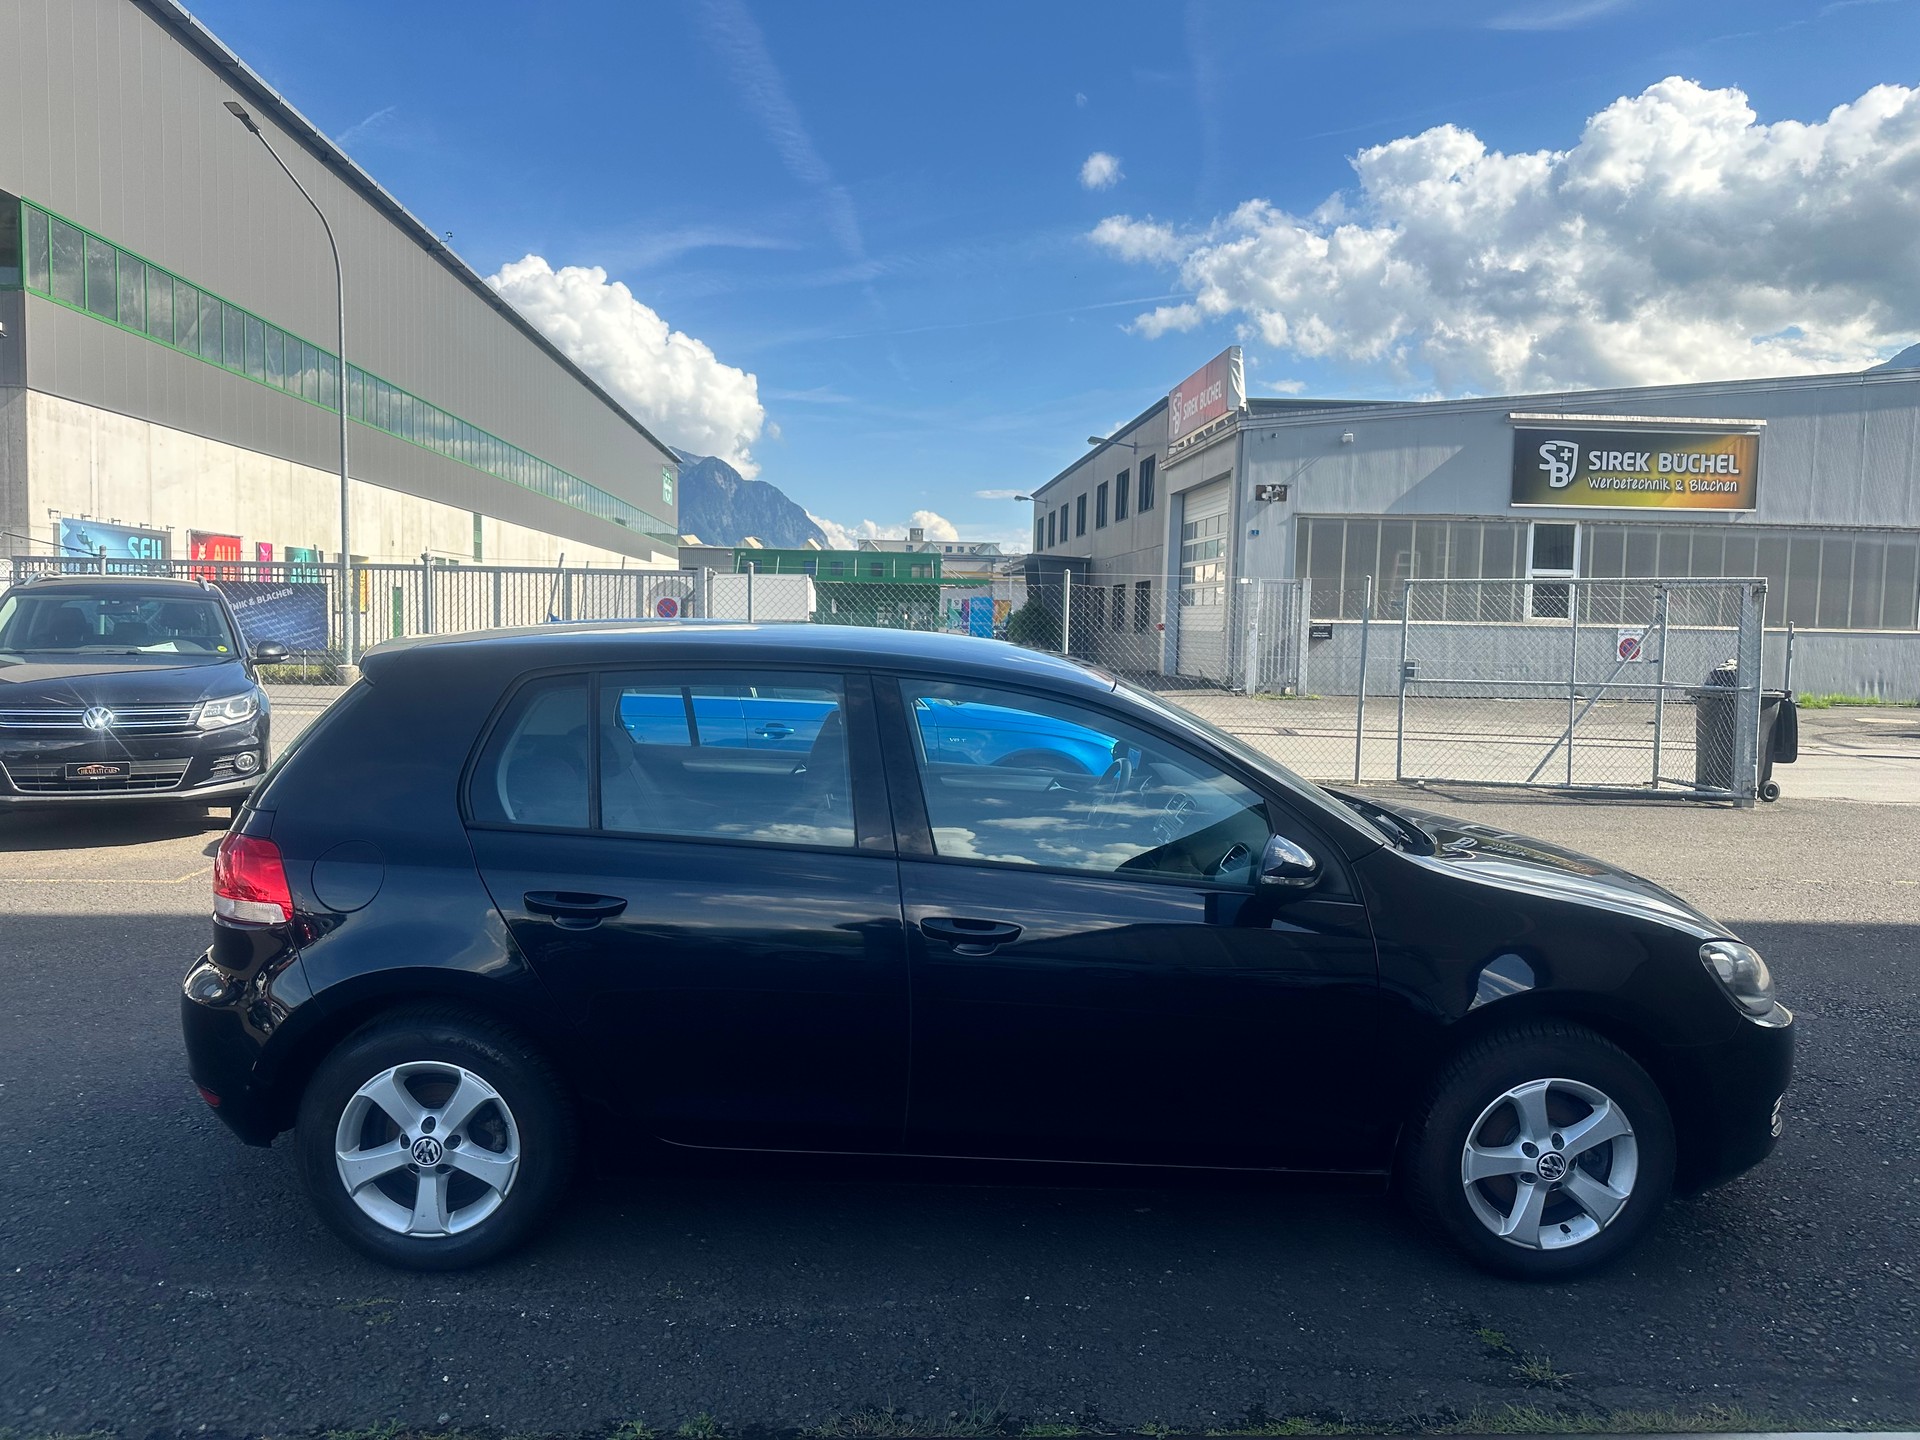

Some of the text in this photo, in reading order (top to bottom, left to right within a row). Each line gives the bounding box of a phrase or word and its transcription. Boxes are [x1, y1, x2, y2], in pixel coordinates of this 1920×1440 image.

[1183, 395, 1199, 420] SIREK
[1588, 450, 1740, 474] SIREK BÜCHEL
[1587, 476, 1737, 492] Werbetechnik & Blachen
[256, 588, 294, 604] BLACHEN
